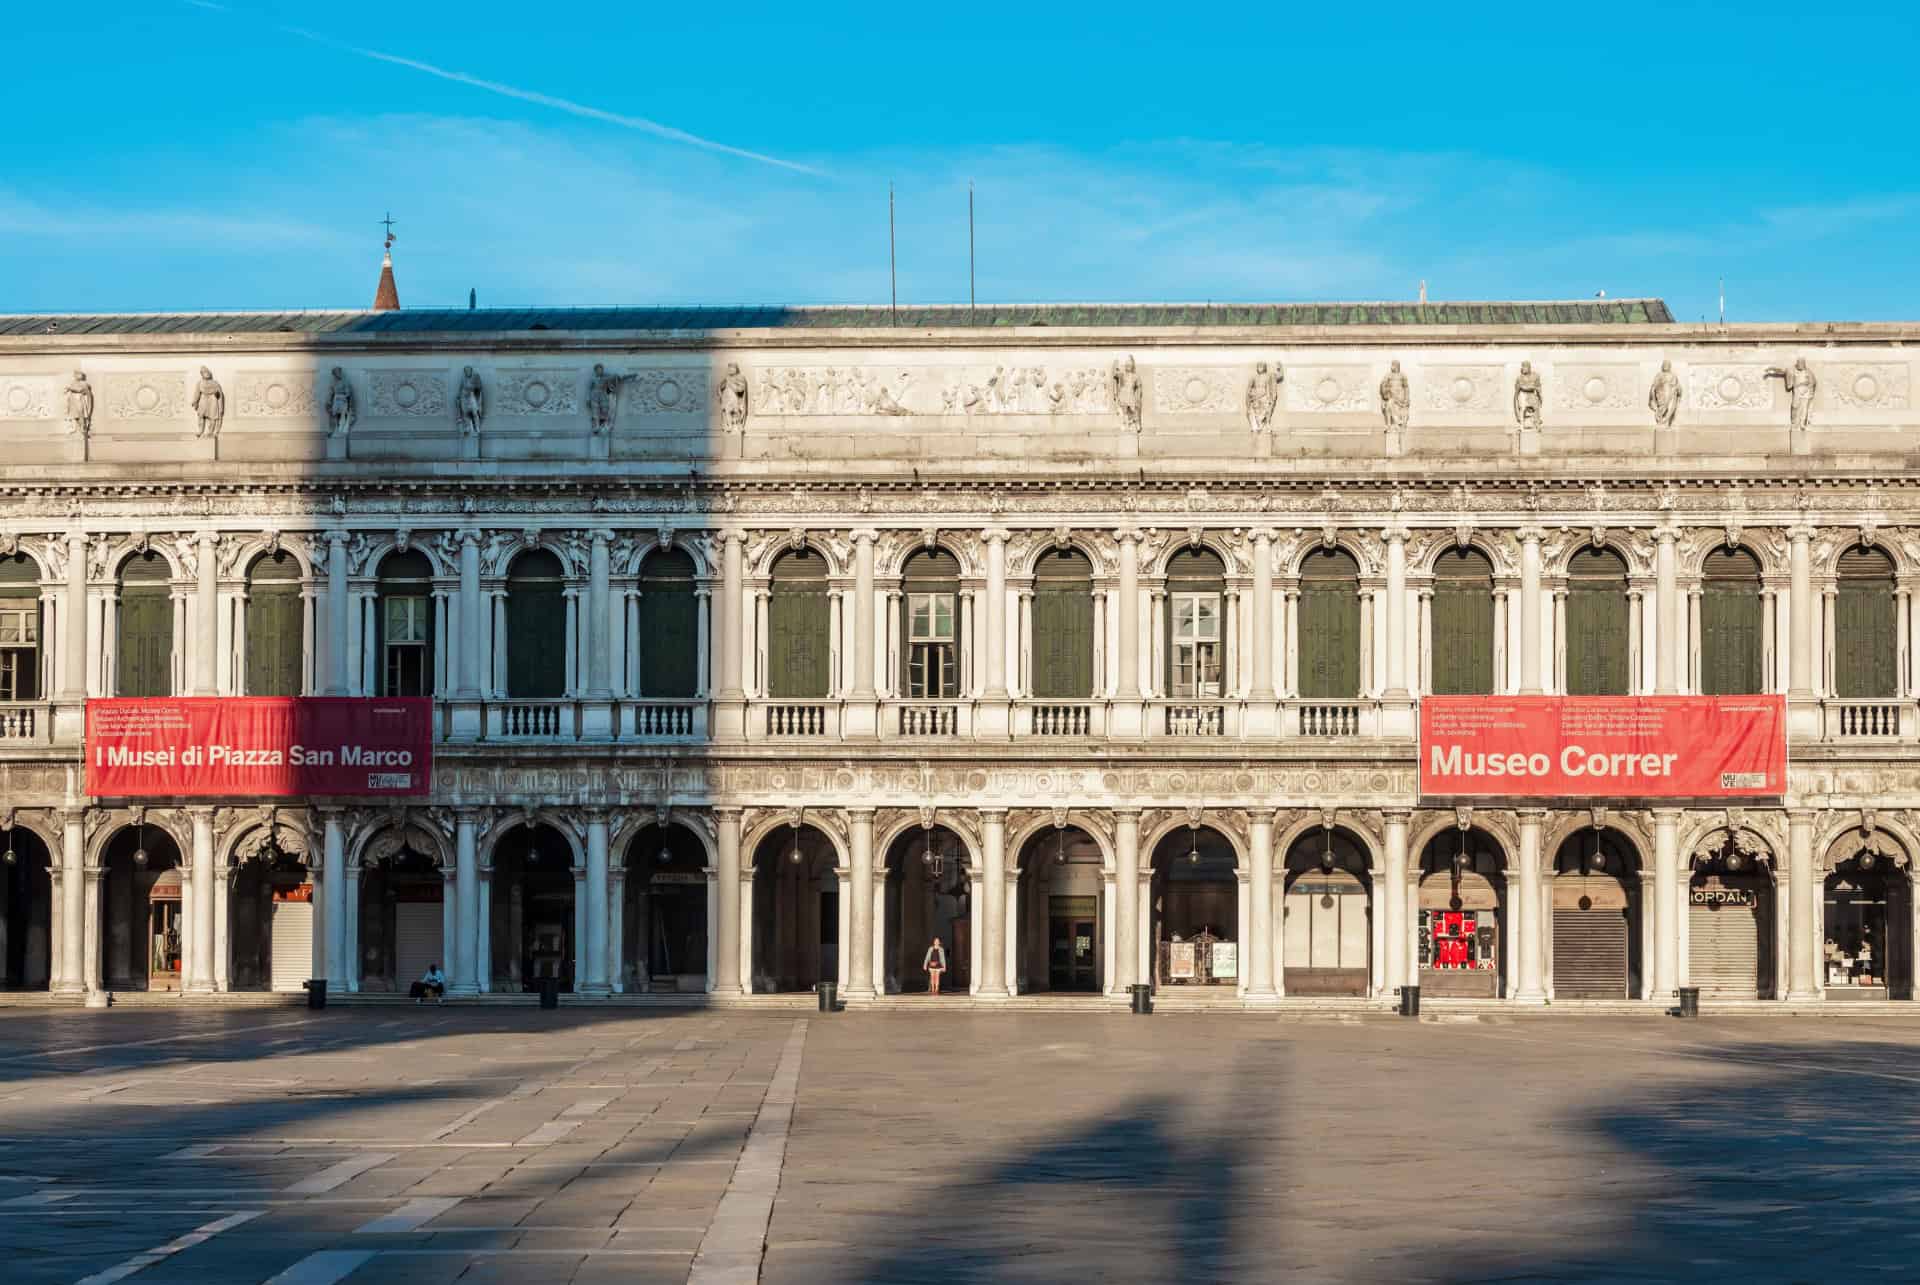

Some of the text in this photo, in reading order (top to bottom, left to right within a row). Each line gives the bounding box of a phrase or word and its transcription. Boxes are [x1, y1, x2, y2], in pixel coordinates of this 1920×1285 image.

[96, 745, 412, 767] I Musei di Piazza San Marco
[1431, 744, 1678, 776] Museo Correr
